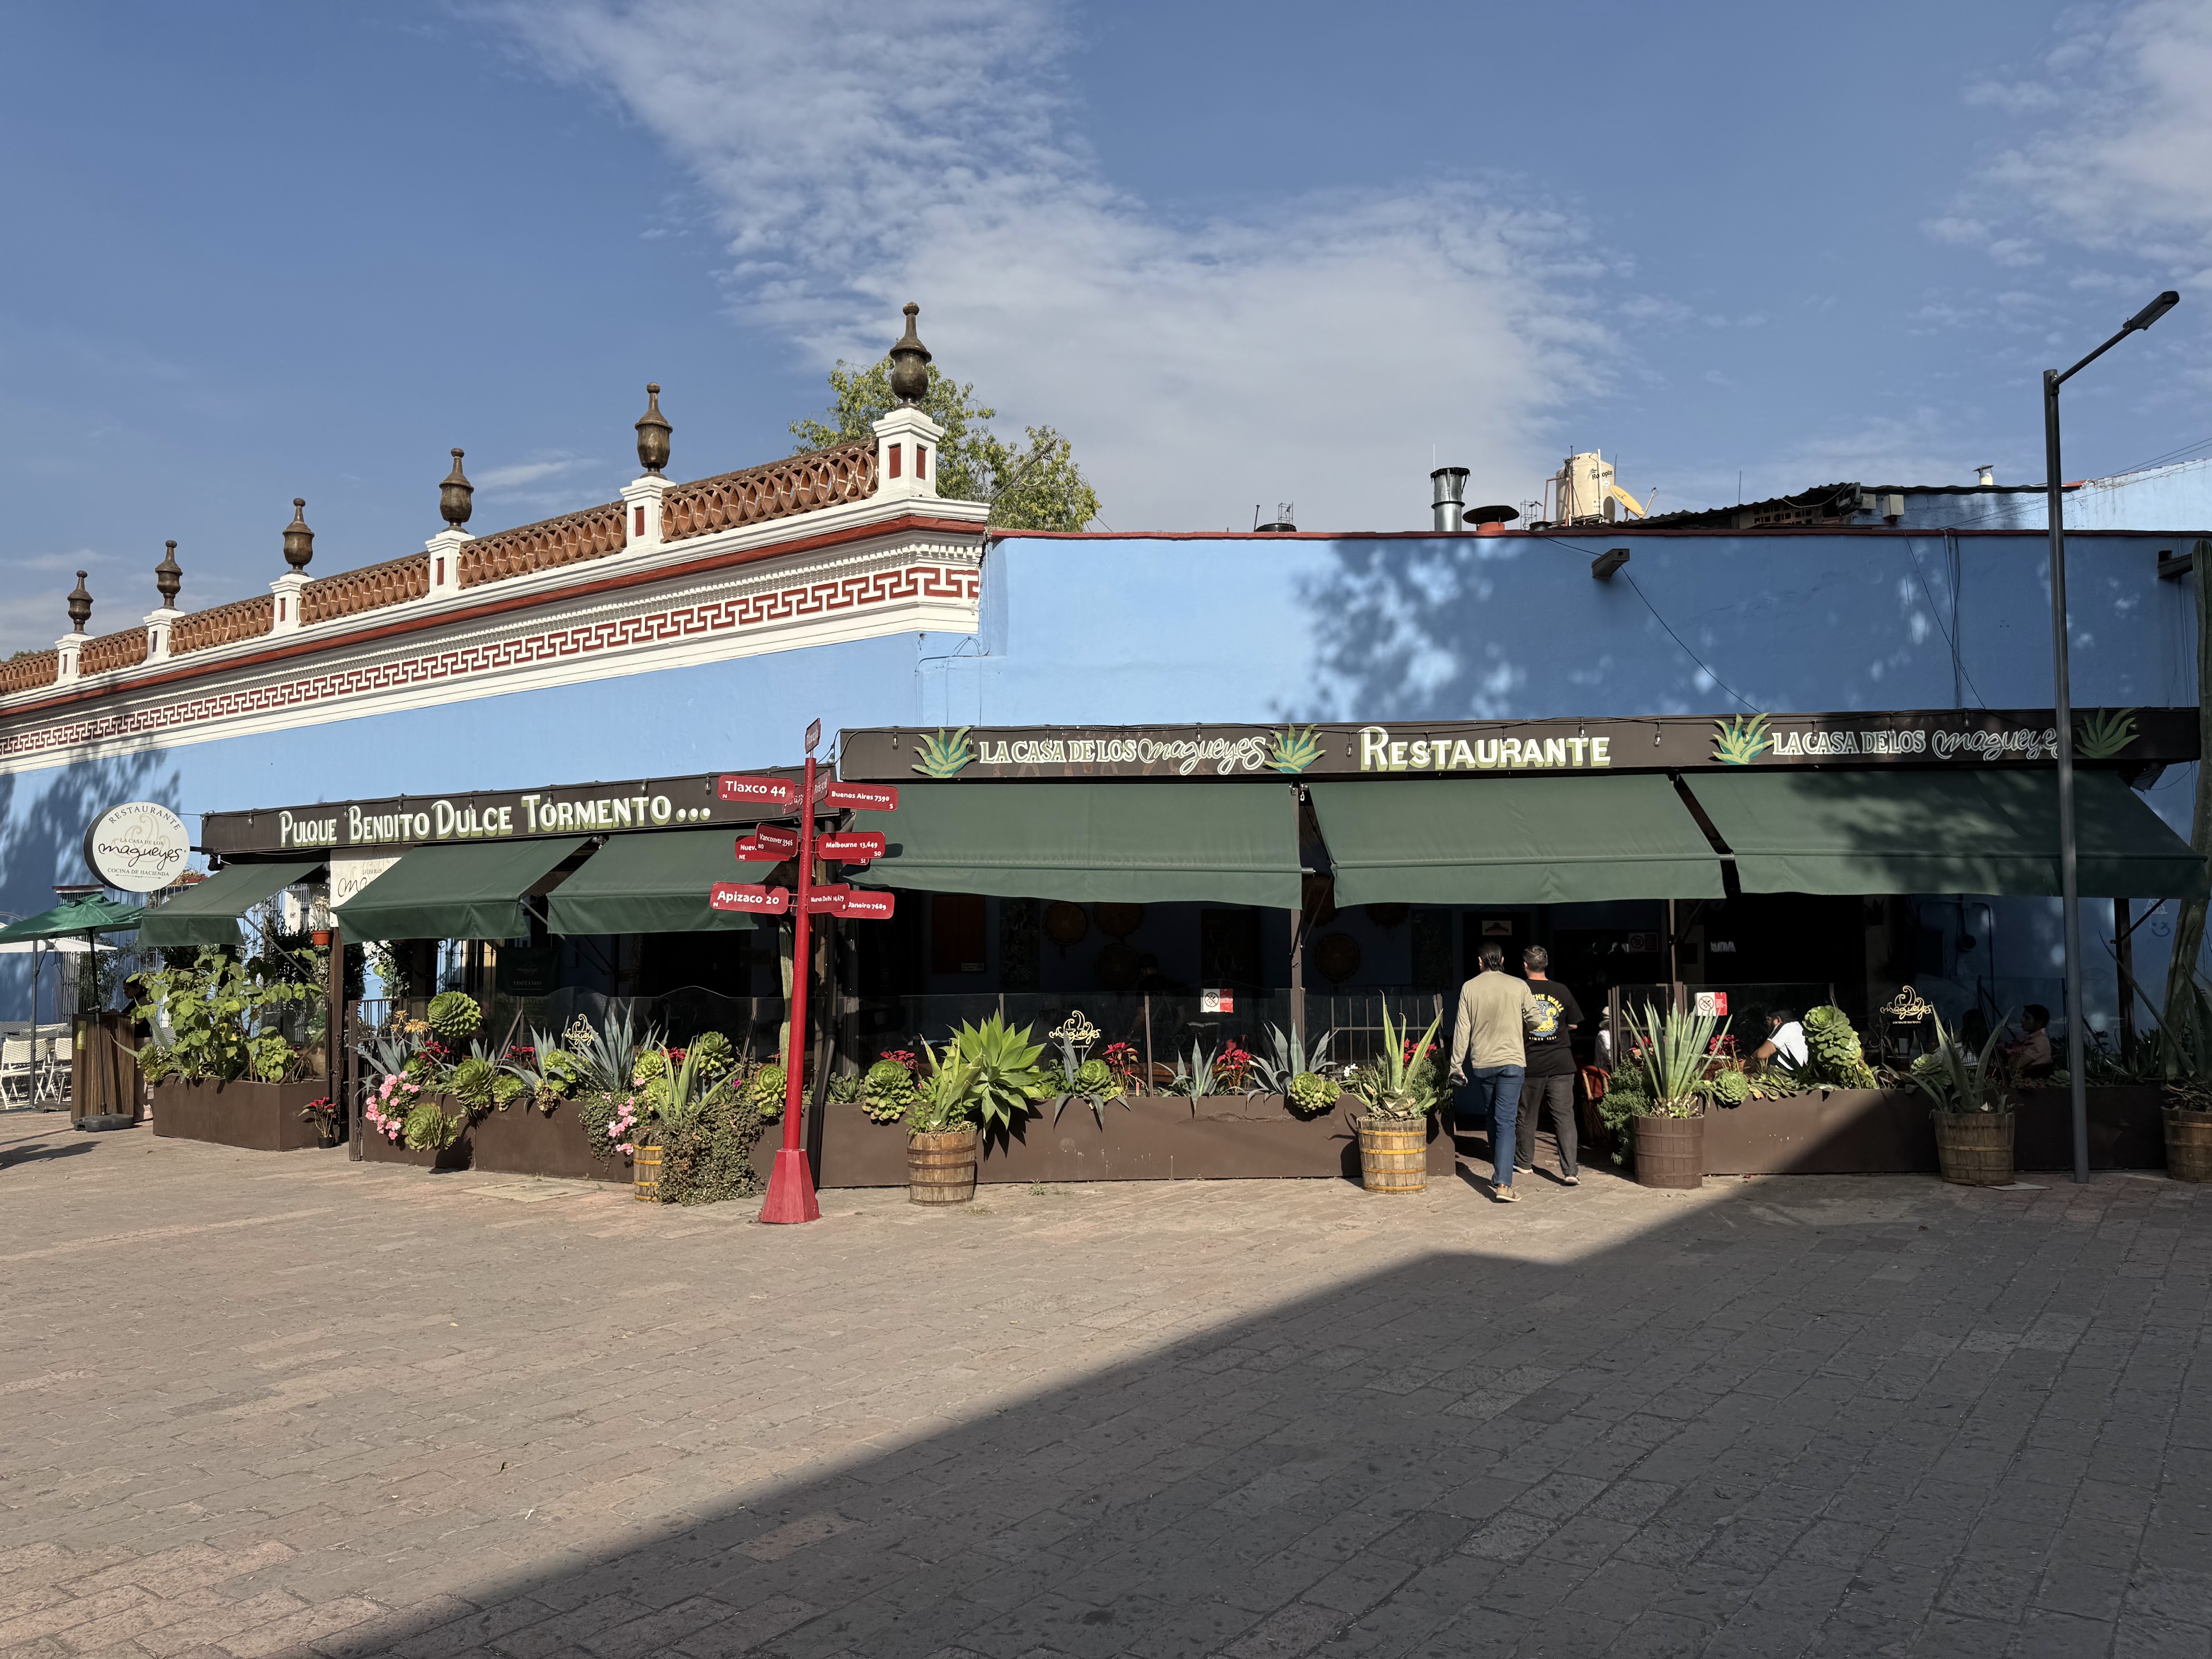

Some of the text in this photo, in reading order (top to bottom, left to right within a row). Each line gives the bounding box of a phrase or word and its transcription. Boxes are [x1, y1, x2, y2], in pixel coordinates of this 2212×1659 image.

[1592, 470, 1613, 480] Rooplas
[1358, 726, 1611, 771] RESTAURANTE
[1772, 732, 1805, 755] LA
[1802, 731, 1860, 755] CASA
[1860, 731, 1888, 754] DE
[1888, 730, 1926, 753] LOS
[979, 736, 1266, 776] LA CASA DE LOS magueyes
[725, 781, 786, 798] Tlaxco 44
[108, 806, 181, 830] RESTAURANTE
[278, 794, 711, 847] PULQUE BENDITO DULCE TORMENTO...
[759, 833, 782, 844] Vancouver
[98, 843, 182, 871] magueyes
[717, 891, 779, 905] Apizaco 20
